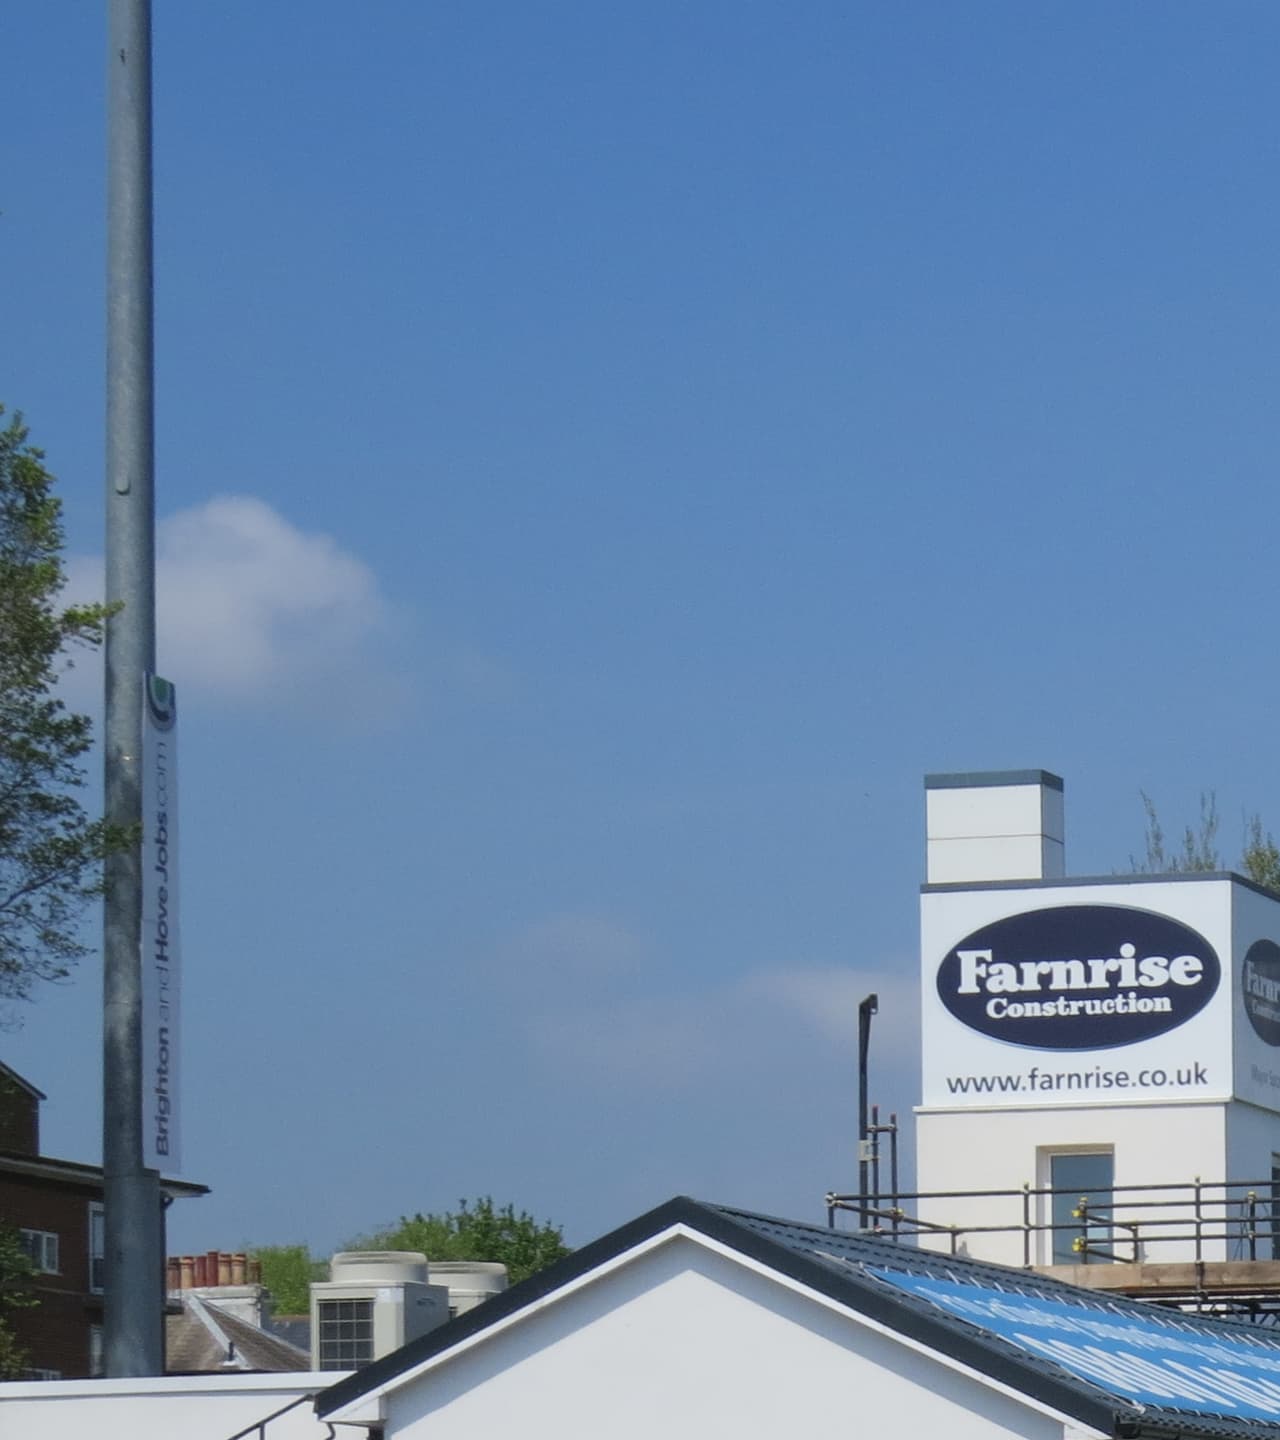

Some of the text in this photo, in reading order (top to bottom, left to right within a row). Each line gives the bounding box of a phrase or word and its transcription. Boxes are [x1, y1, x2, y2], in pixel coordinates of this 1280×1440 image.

[156, 966, 169, 1022] and
[956, 943, 1204, 995] Farnrise
[986, 993, 1172, 1020] Construction
[155, 1027, 169, 1156] Brighton
[947, 1062, 1208, 1094] www.farnrise.co.uk
